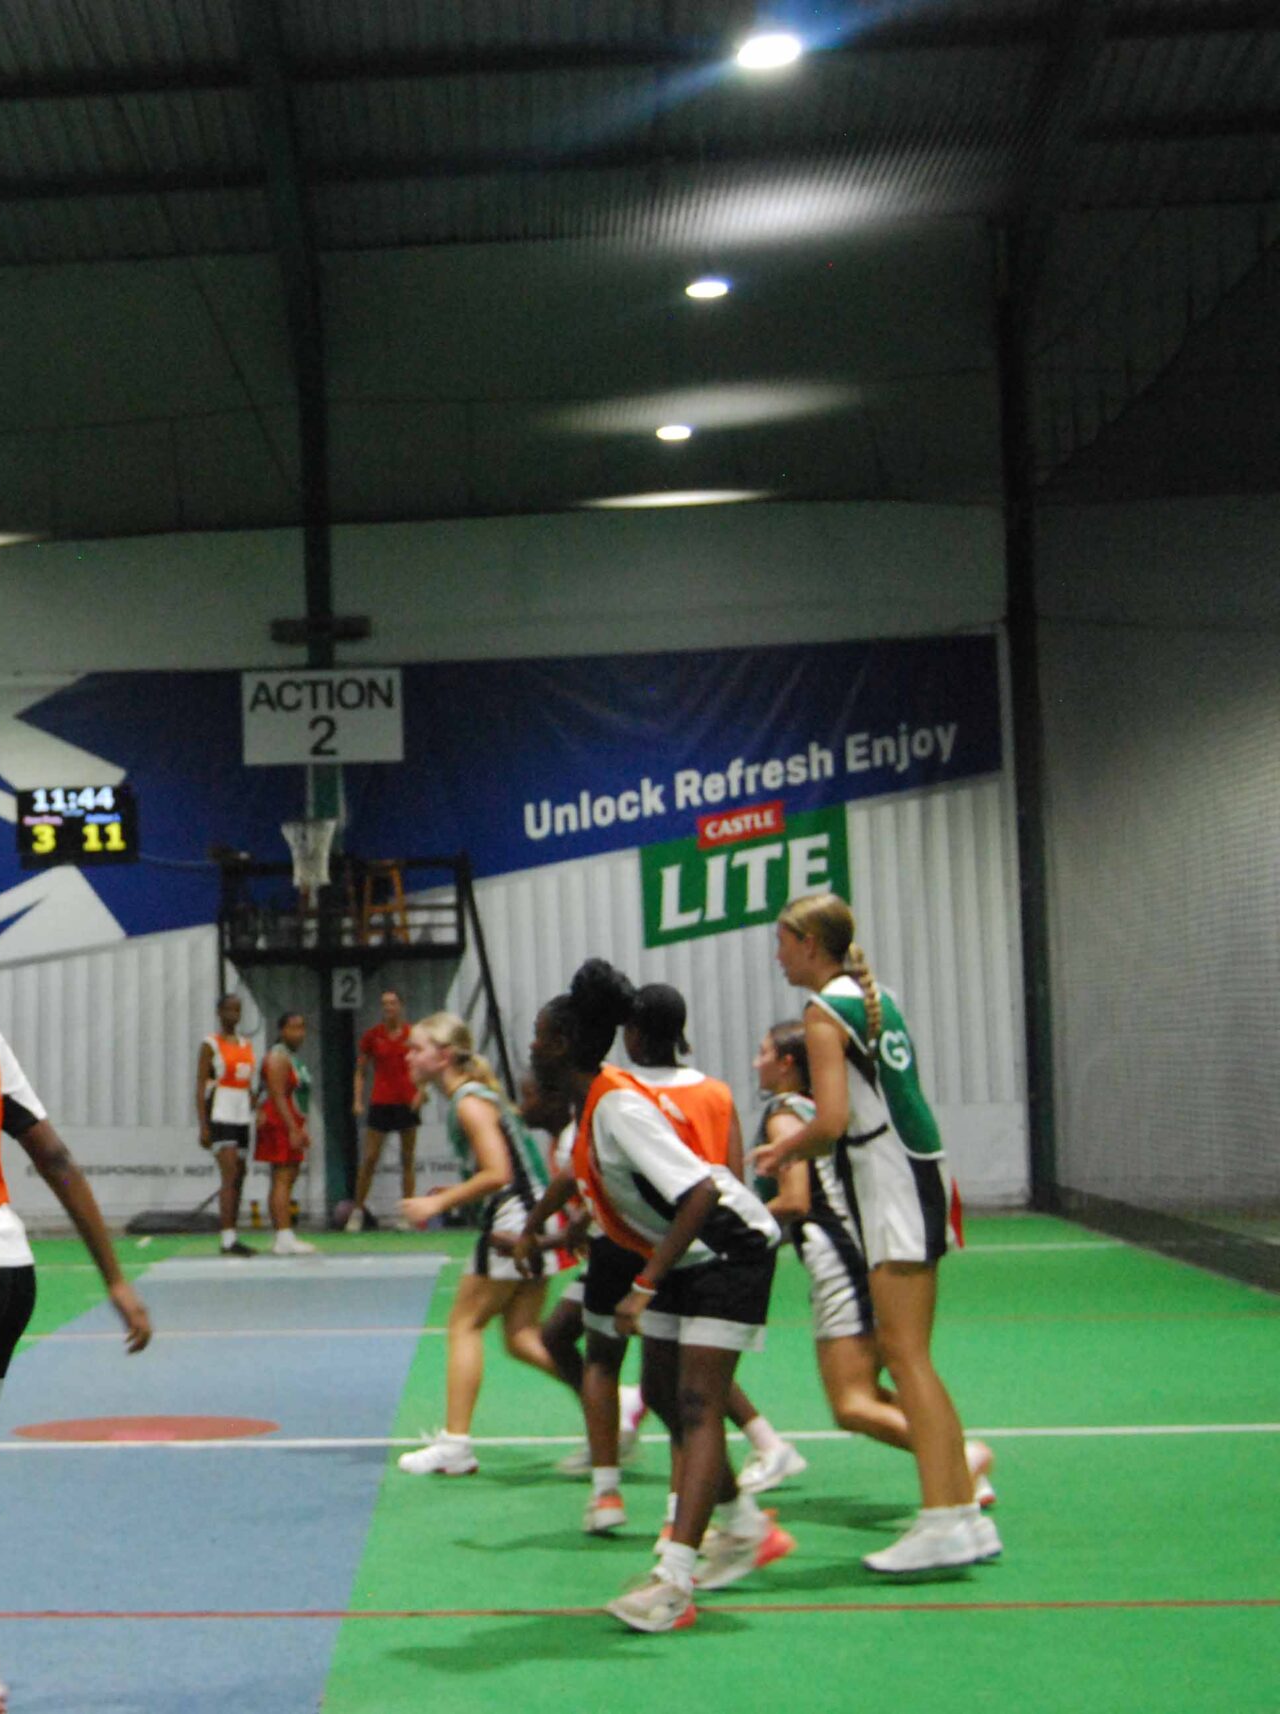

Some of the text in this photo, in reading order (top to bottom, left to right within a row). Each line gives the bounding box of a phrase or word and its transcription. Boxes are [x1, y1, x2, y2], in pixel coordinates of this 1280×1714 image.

[249, 677, 395, 713] ACTION
[308, 714, 339, 757] 2
[523, 721, 958, 841] Unlock Refresh Enjoy
[32, 786, 116, 813] 11:44
[32, 822, 127, 855] 3 11
[703, 809, 776, 841] CASTLE
[657, 833, 832, 932] LITE
[340, 974, 358, 1003] 2
